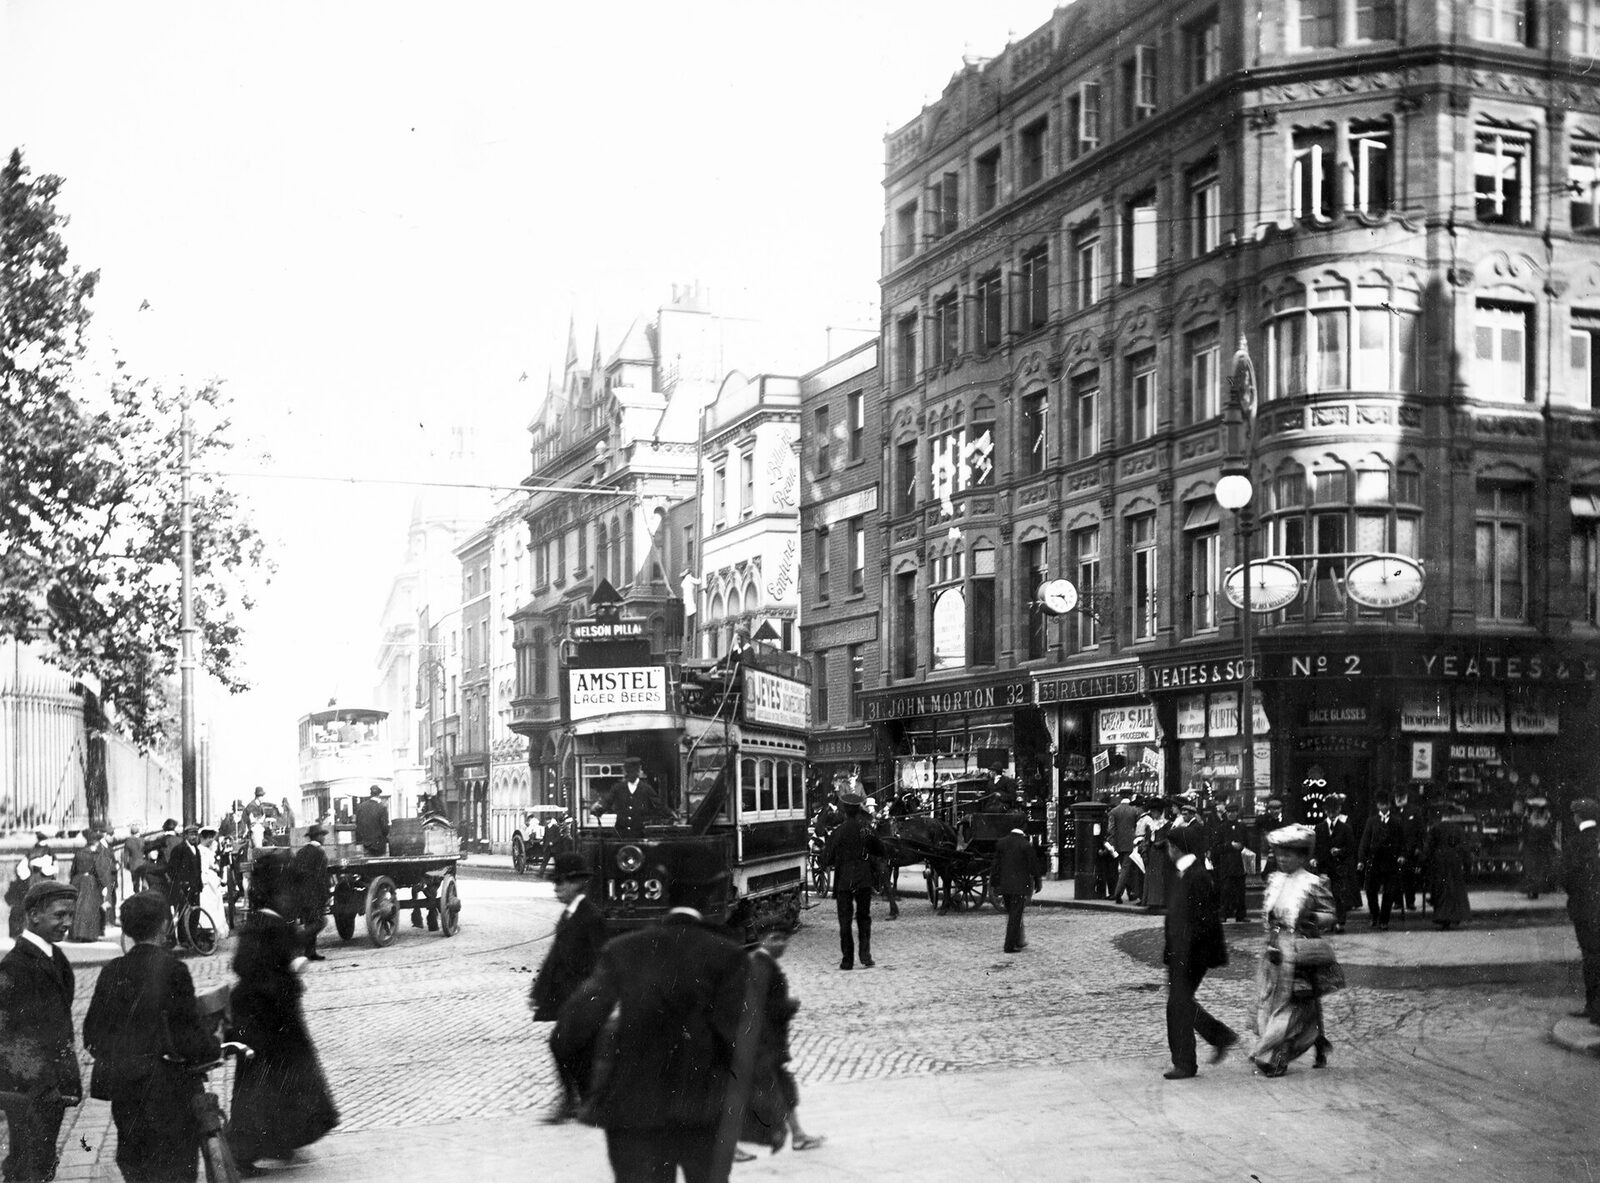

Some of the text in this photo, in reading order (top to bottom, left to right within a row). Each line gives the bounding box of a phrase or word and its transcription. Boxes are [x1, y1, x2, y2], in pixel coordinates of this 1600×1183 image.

[574, 624, 611, 637] NELSON
[1344, 655, 1361, 674] 2
[1422, 655, 1542, 679] YEATES
[1042, 673, 1136, 700] 33 RACINE 33
[1153, 665, 1207, 688] YEATES
[1212, 666, 1222, 682] &
[573, 690, 661, 705] LAGER BEERS
[868, 683, 1024, 720] 31 JOHN MORTON 32
[1209, 707, 1239, 730] CURTIS
[1330, 707, 1366, 721] GLASSES
[607, 878, 662, 901] 129
